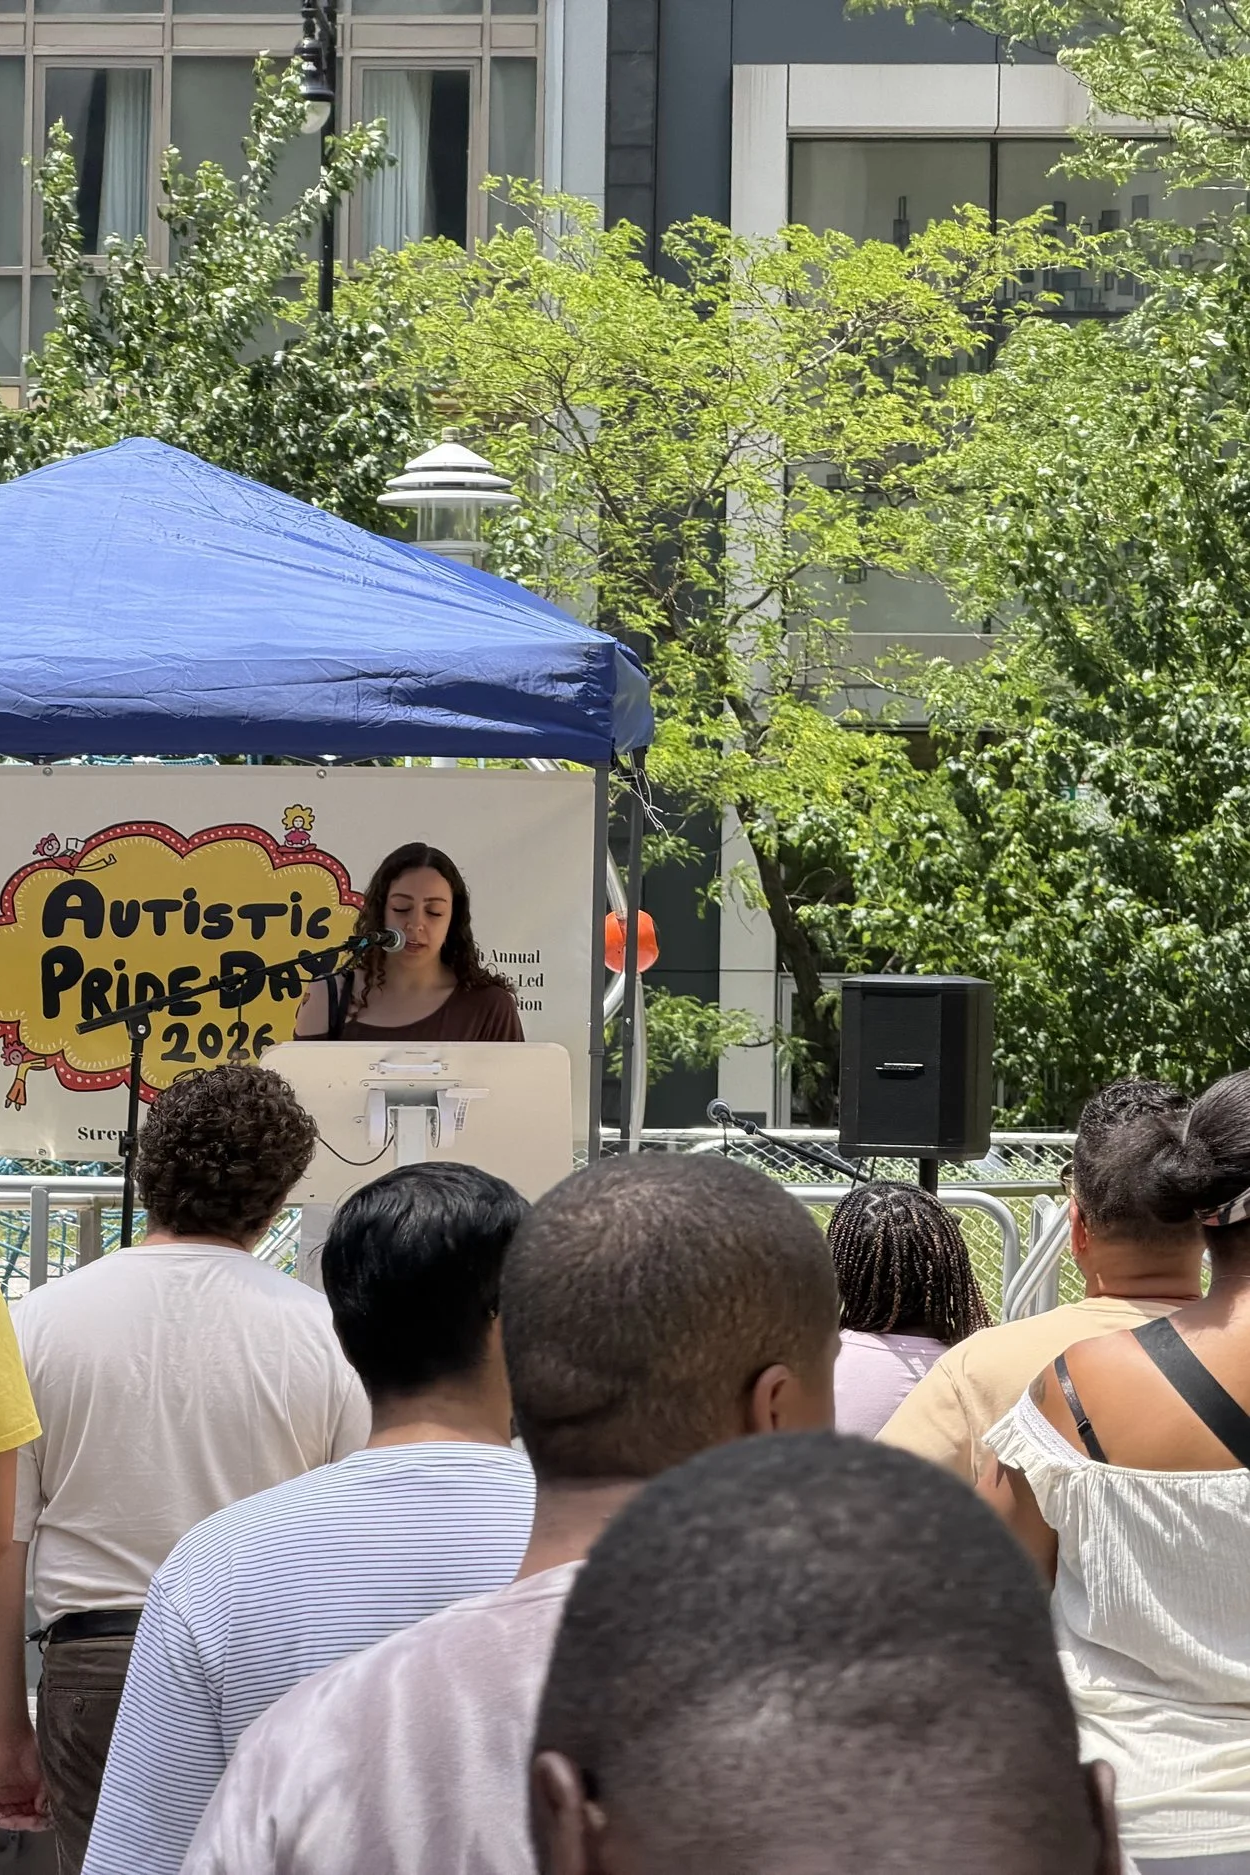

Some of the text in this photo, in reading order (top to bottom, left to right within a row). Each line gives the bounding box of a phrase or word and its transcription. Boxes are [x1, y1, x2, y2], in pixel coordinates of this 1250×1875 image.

[490, 949, 540, 963] Annual
[517, 996, 543, 1011] ion
[160, 1021, 276, 1063] 2026
